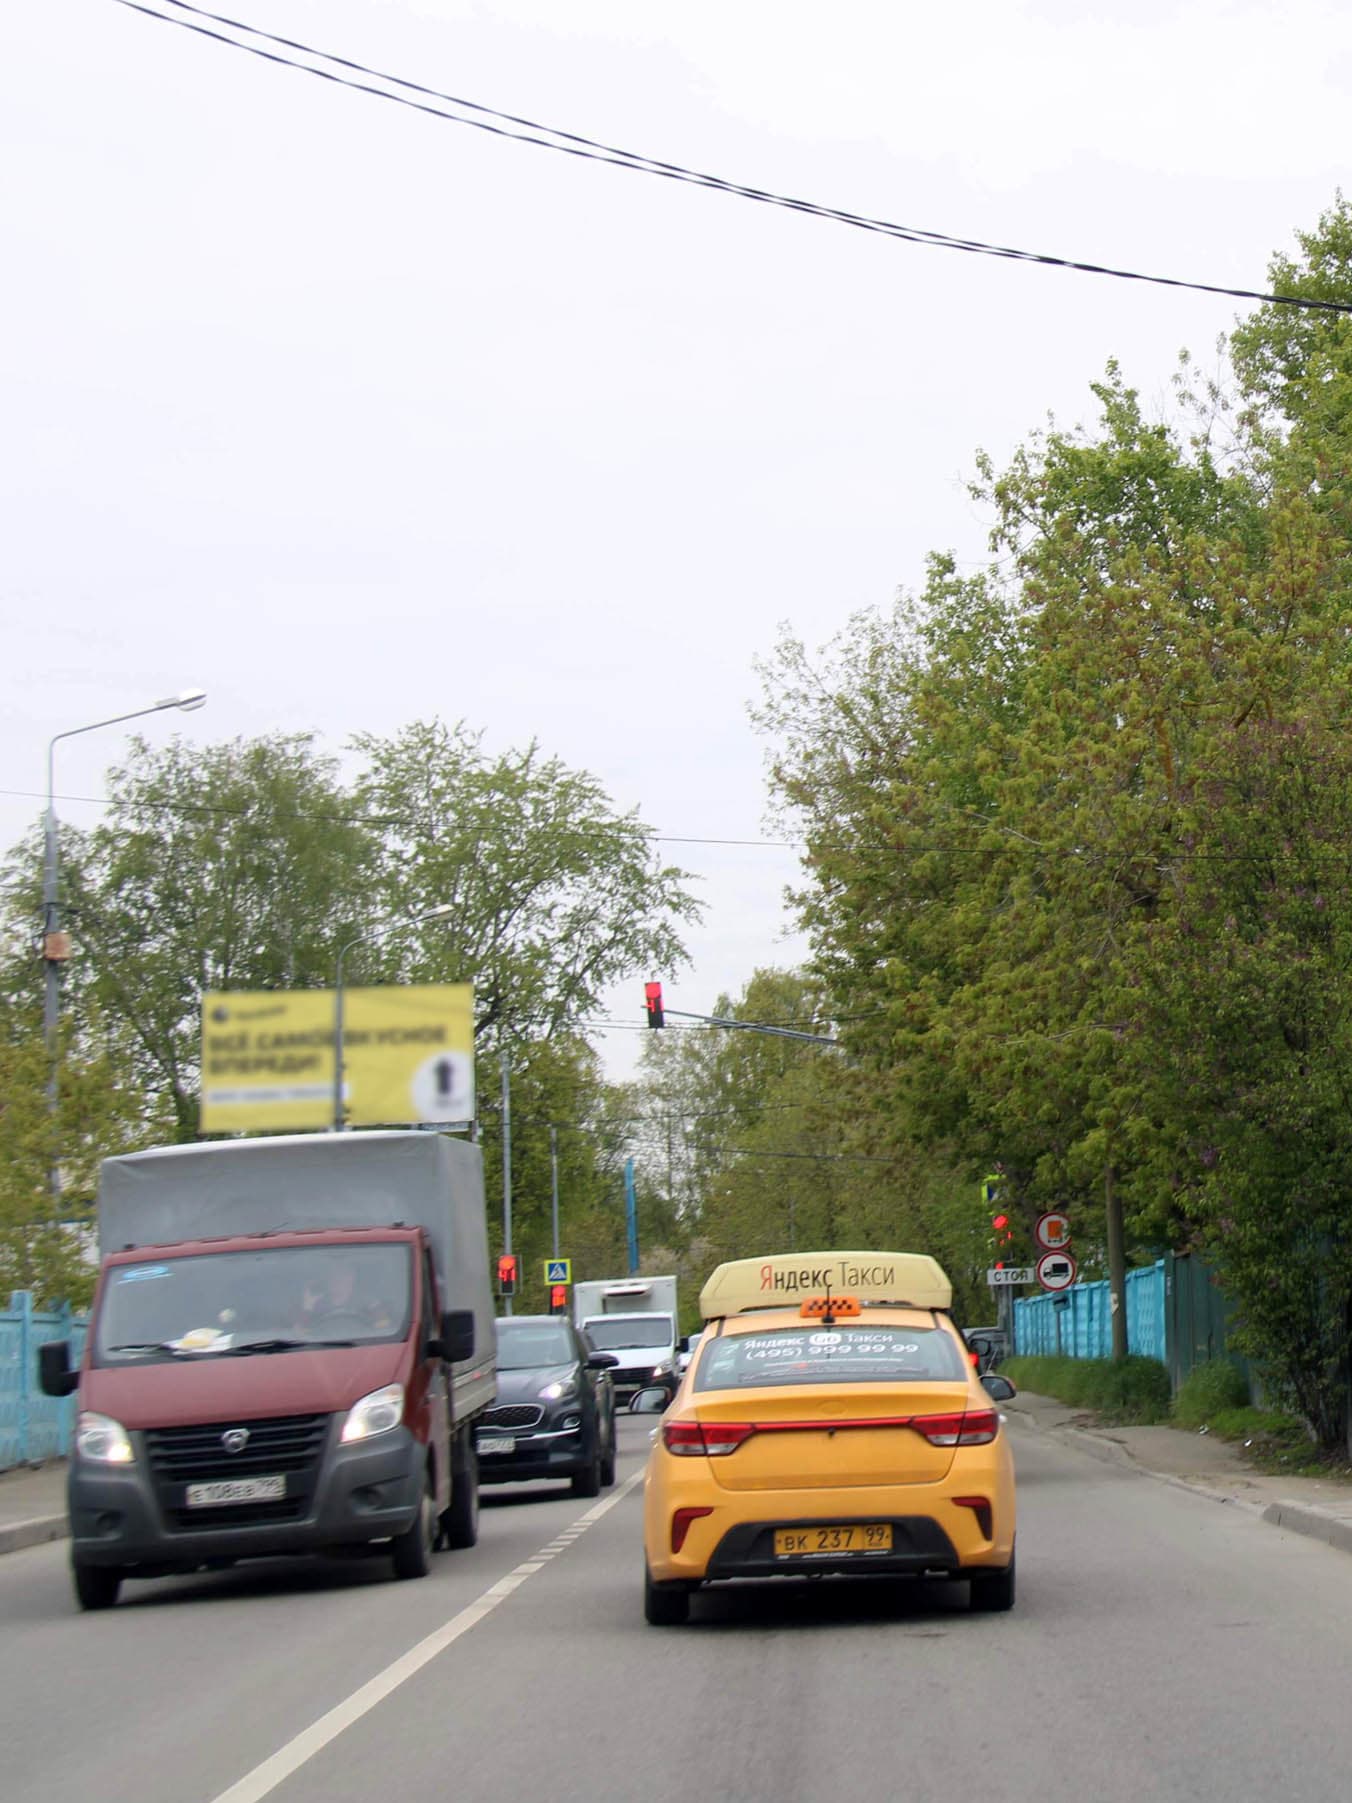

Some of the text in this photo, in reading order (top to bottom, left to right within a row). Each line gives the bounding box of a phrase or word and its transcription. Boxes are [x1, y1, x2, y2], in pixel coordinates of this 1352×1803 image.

[760, 1261, 895, 1292] Яндекс Такси
[743, 1337, 806, 1350] Яндекс
[746, 1343, 919, 1360] (495) 999 99 99
[784, 1526, 885, 1551] ВК 237 99
